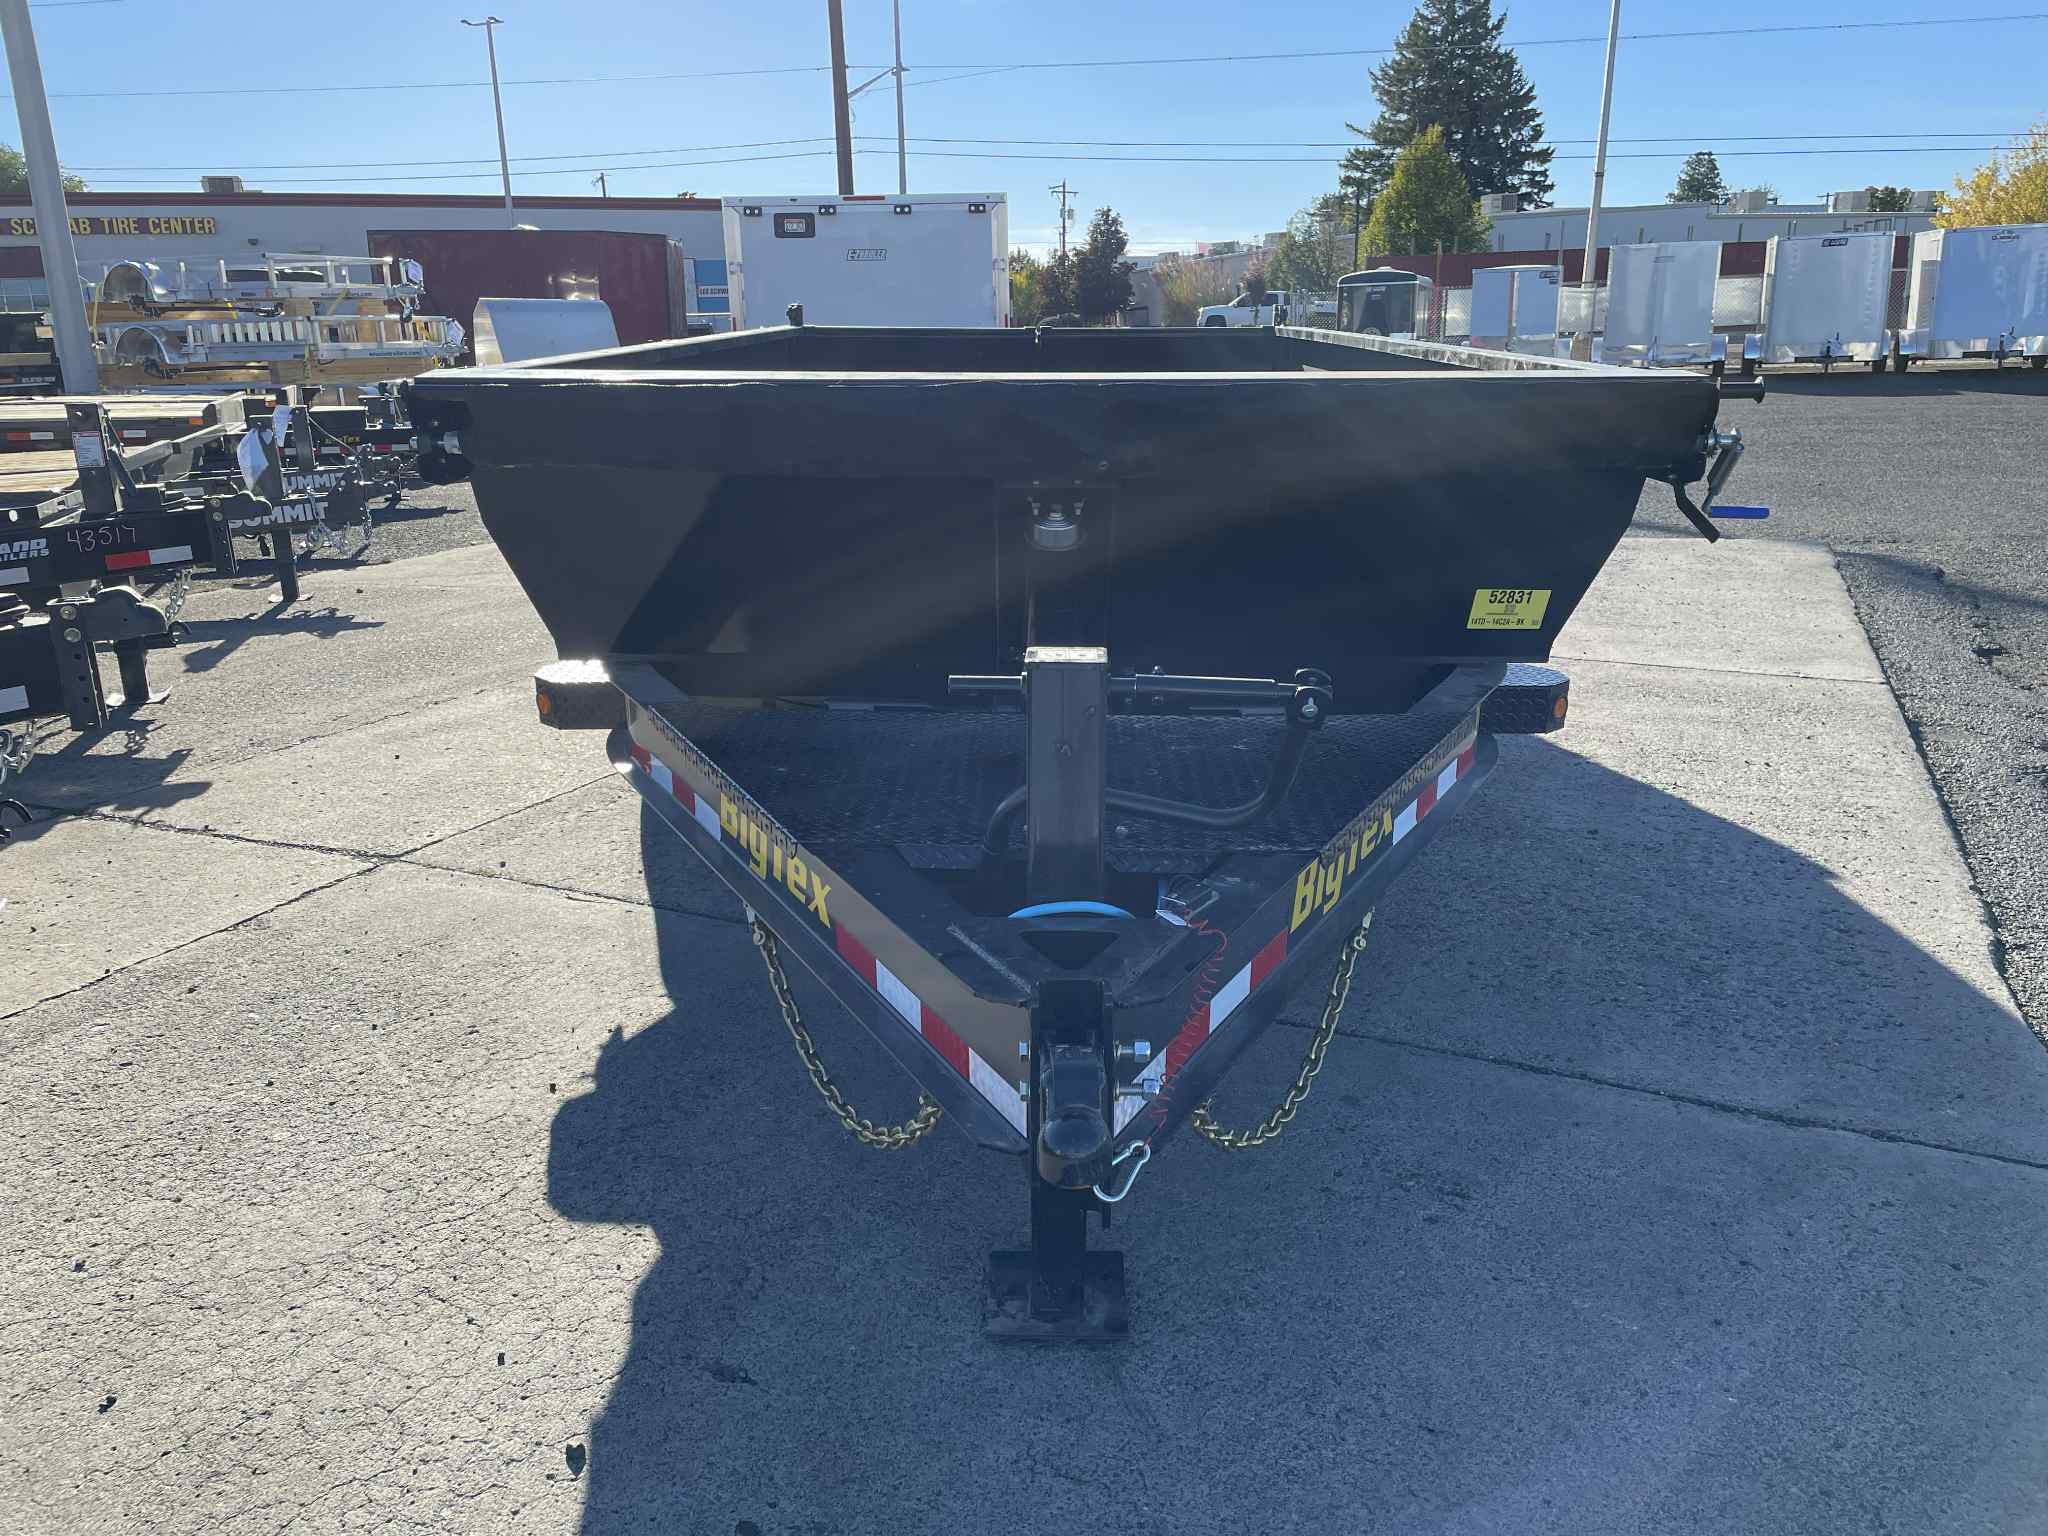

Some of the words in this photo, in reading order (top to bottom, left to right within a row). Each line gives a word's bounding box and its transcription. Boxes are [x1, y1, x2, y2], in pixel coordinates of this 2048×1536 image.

[10, 218, 91, 235] SCAB
[100, 218, 139, 234] TIRE
[149, 217, 216, 234] CENTER
[66, 525, 137, 553] 43517
[0, 548, 49, 562] ILERS
[1488, 590, 1534, 604] 52831
